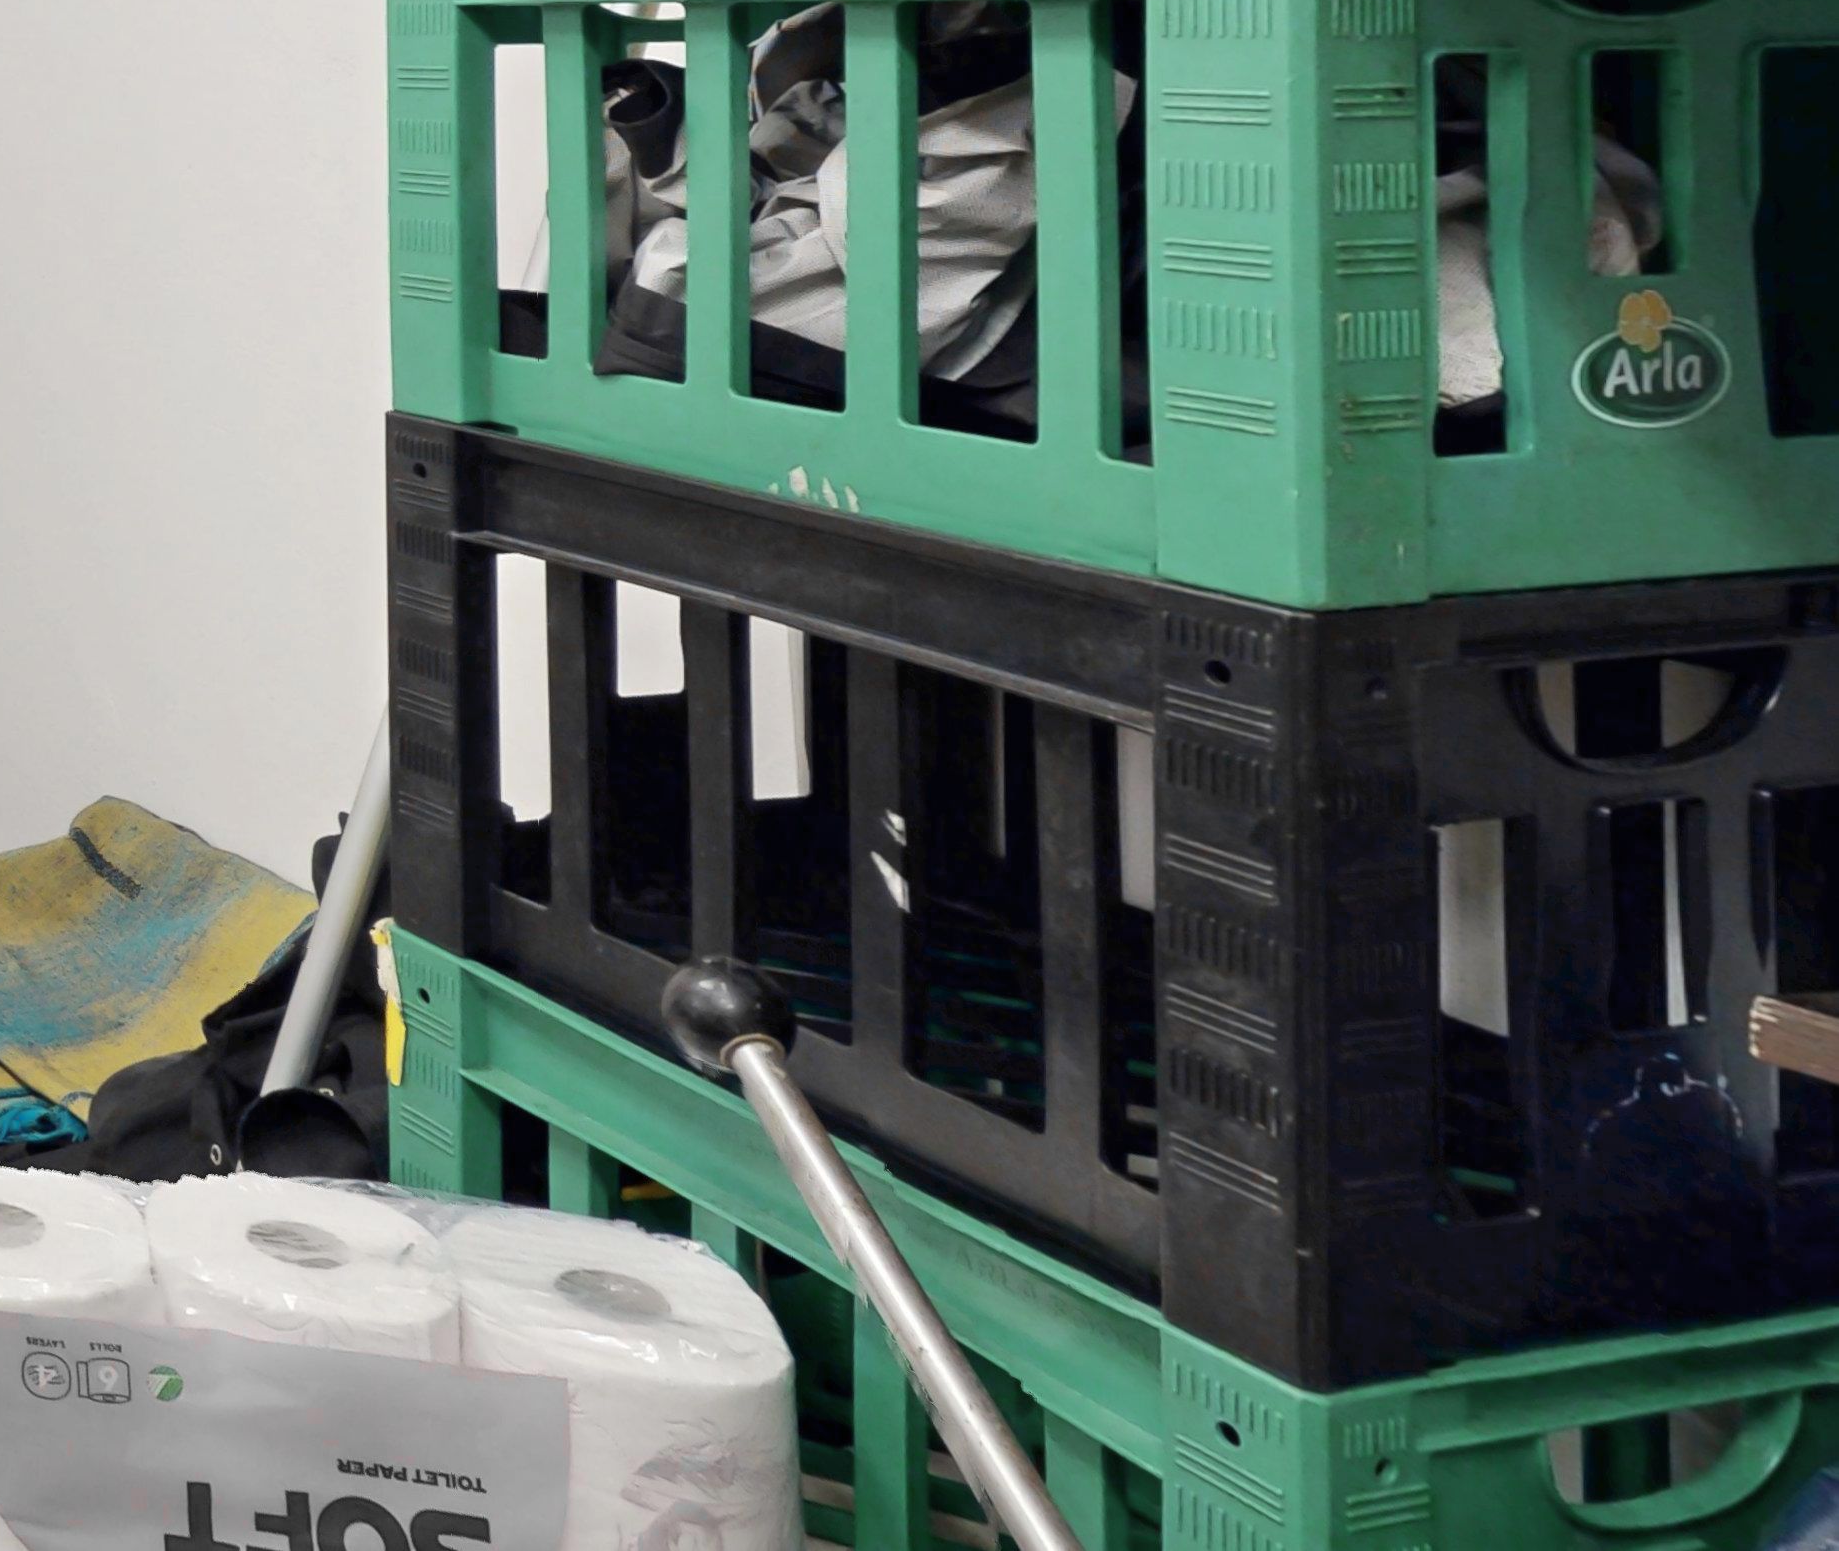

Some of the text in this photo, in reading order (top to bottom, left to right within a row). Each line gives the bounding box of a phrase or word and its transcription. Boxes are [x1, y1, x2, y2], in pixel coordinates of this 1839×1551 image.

[1603, 340, 1704, 398] Arla
[25, 1336, 66, 1349] LAYERS
[89, 1341, 122, 1353] ROLLS
[336, 1458, 487, 1494] TOILET PAPER
